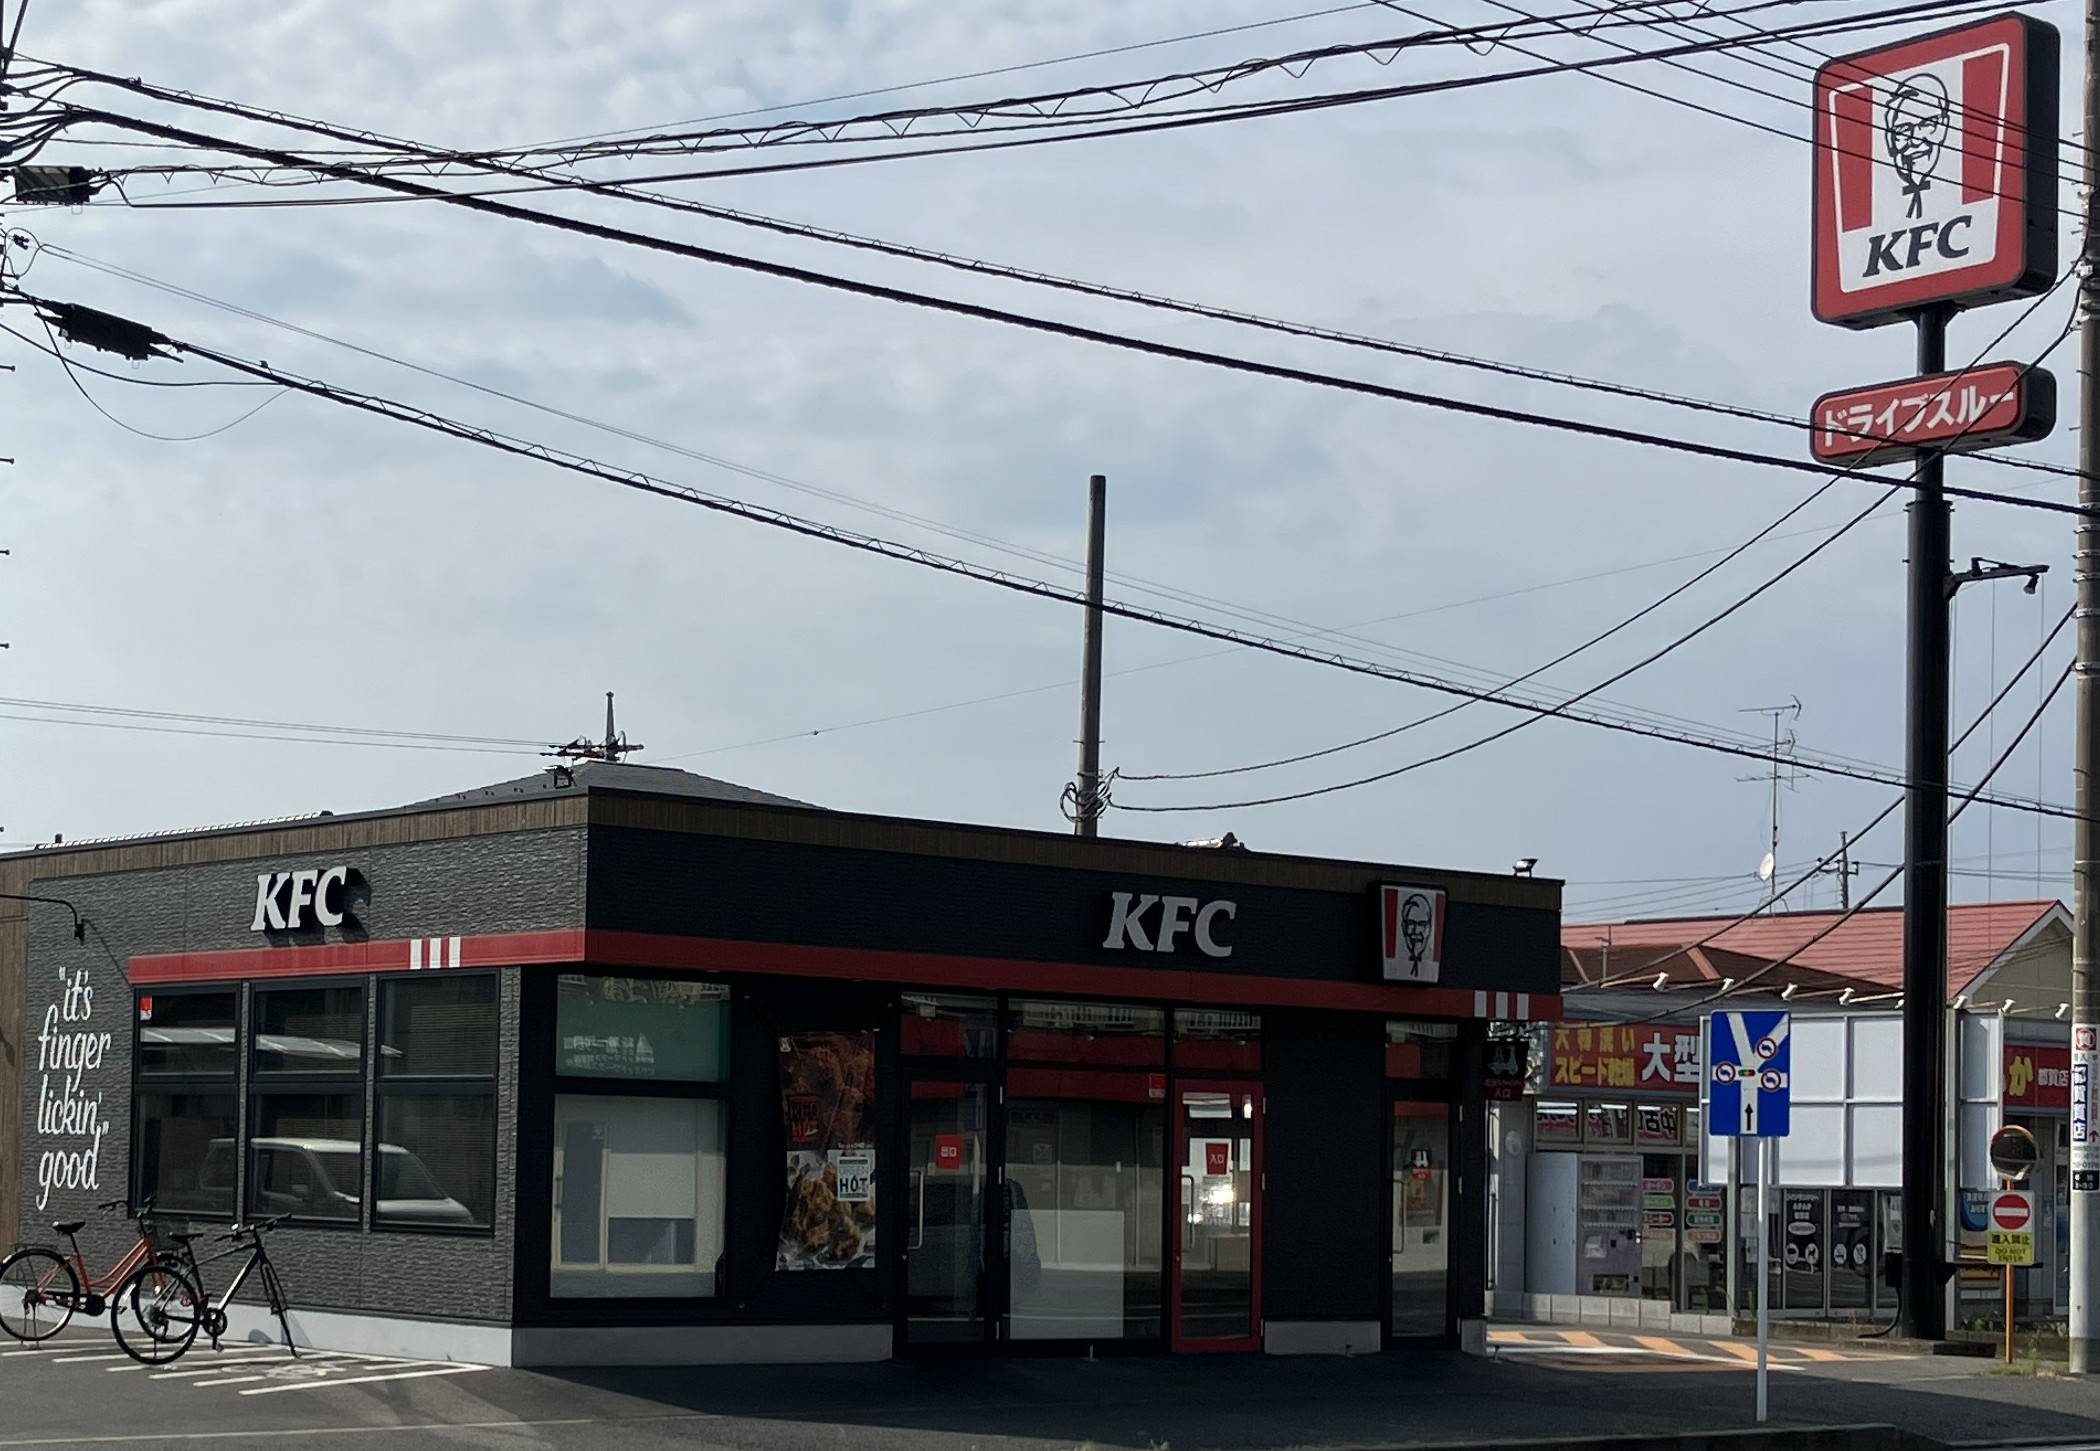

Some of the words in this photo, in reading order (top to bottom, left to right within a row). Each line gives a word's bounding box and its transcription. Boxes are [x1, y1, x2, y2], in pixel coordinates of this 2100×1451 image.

[1862, 214, 1973, 279] KFC
[1823, 384, 2016, 447] ドライブスルー
[250, 865, 347, 932] KFC
[1102, 890, 1238, 958] KFC
[37, 1003, 112, 1093] finger
[839, 1175, 869, 1193] HOT
